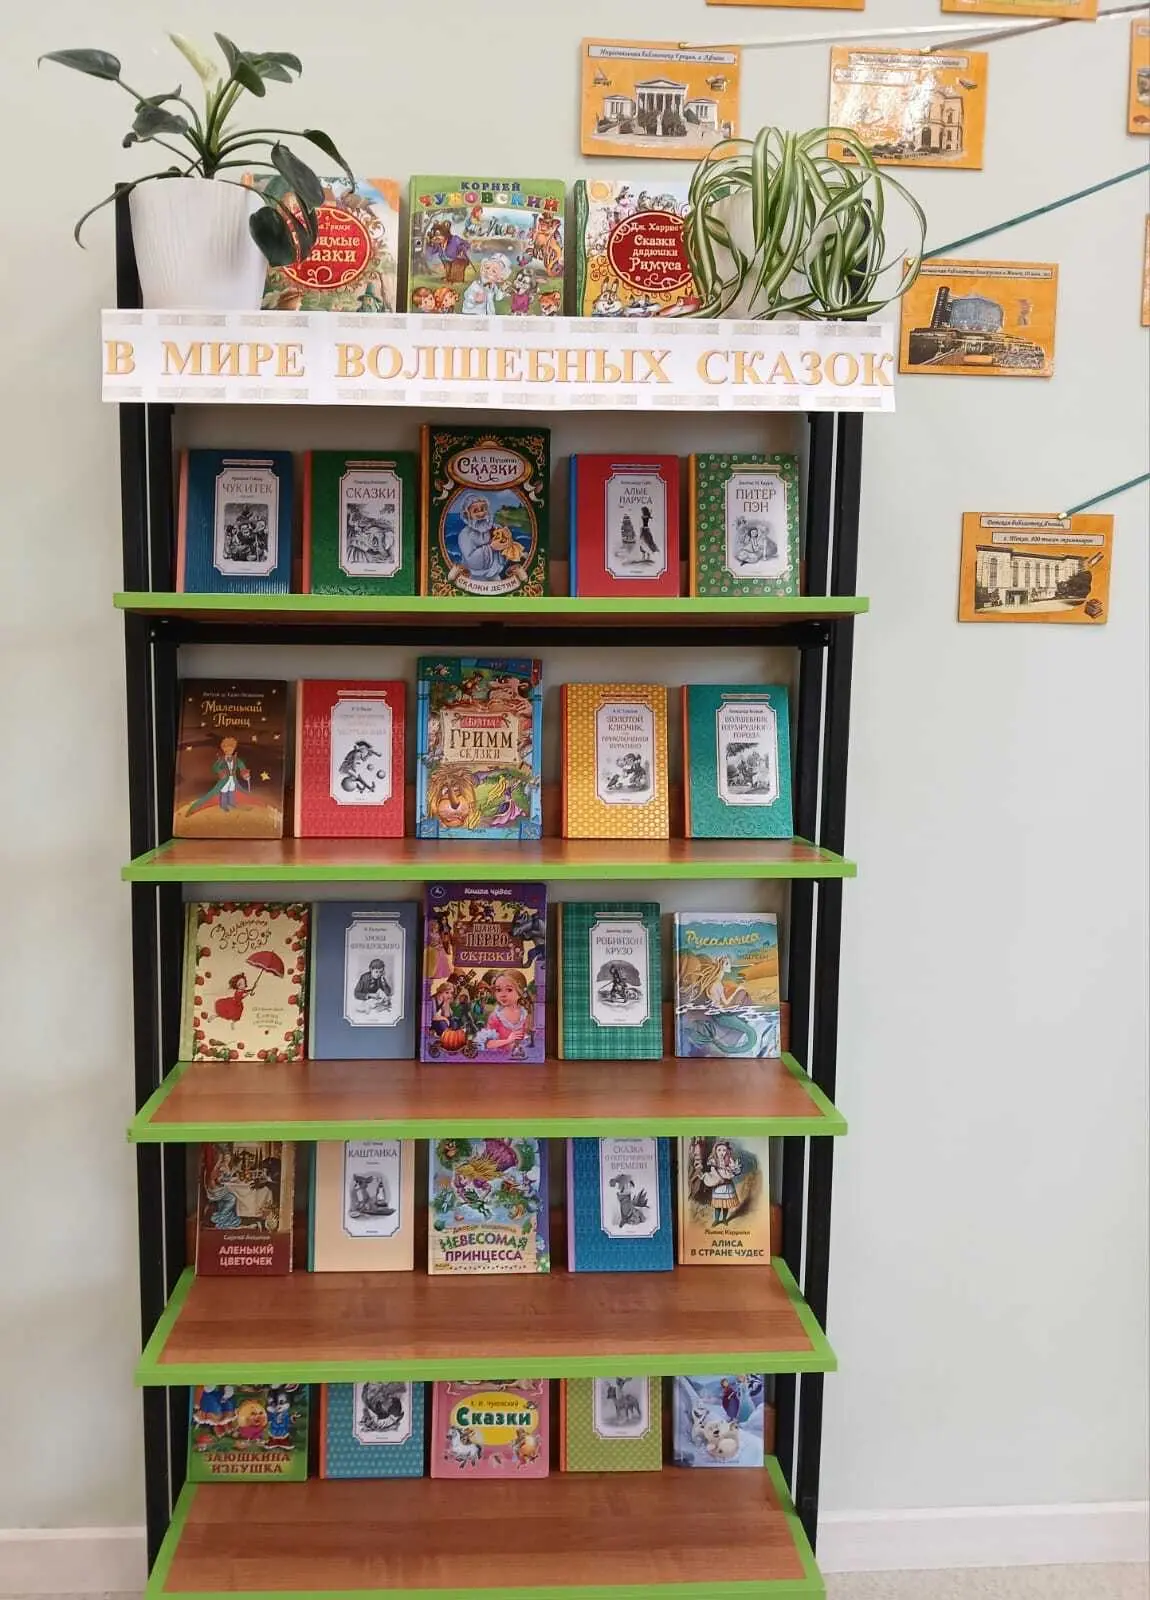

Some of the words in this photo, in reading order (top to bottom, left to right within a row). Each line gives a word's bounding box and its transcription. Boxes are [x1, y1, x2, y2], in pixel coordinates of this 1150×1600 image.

[461, 182, 520, 192] КОРНЕЙ
[634, 234, 676, 246] Сказки
[306, 248, 357, 263] азки
[632, 249, 678, 257] дядюшки
[628, 257, 682, 272] Римуса
[104, 340, 136, 376] В
[160, 340, 305, 378] МИРЕ
[334, 342, 674, 385] ВОЛШЕБНЫХ
[696, 349, 895, 388] СКАЗОК
[222, 483, 243, 494] ЧУК
[253, 484, 274, 494] ГЕК
[346, 487, 396, 499] СКАЗКИ
[624, 487, 648, 496] АЛЫЕ
[735, 488, 777, 500] ПИТЕР
[619, 495, 653, 505] ПАРУСА
[743, 501, 769, 513] ПЭН
[201, 700, 263, 715] Маленький
[213, 713, 251, 728] Принц
[606, 715, 644, 723] ЗОЛОТОЙ
[450, 729, 513, 748] ГРИММ
[459, 748, 500, 761] СКАЗКИ
[596, 936, 643, 945] РОБИНЗОН
[605, 946, 633, 955] КРУЗО
[459, 951, 515, 963] СКАЗКИ
[348, 1149, 398, 1158] КАШТАНКА
[612, 1145, 644, 1154] СКАЗКА
[440, 1232, 529, 1252] НЕВЕСОМАЯ
[711, 1239, 743, 1248] АЛИСА
[219, 1243, 275, 1255] АЛЕНЬКИЙ
[690, 1249, 697, 1257] В
[698, 1249, 733, 1257] СТРАНЕ
[735, 1249, 765, 1258] ЧУДЕС
[220, 1256, 273, 1268] ЦВЕТОЧЕК
[445, 1250, 523, 1263] ПРИНЦЕССА
[456, 1406, 531, 1426] Сказки
[212, 1463, 284, 1474] ИЗБУШКА
